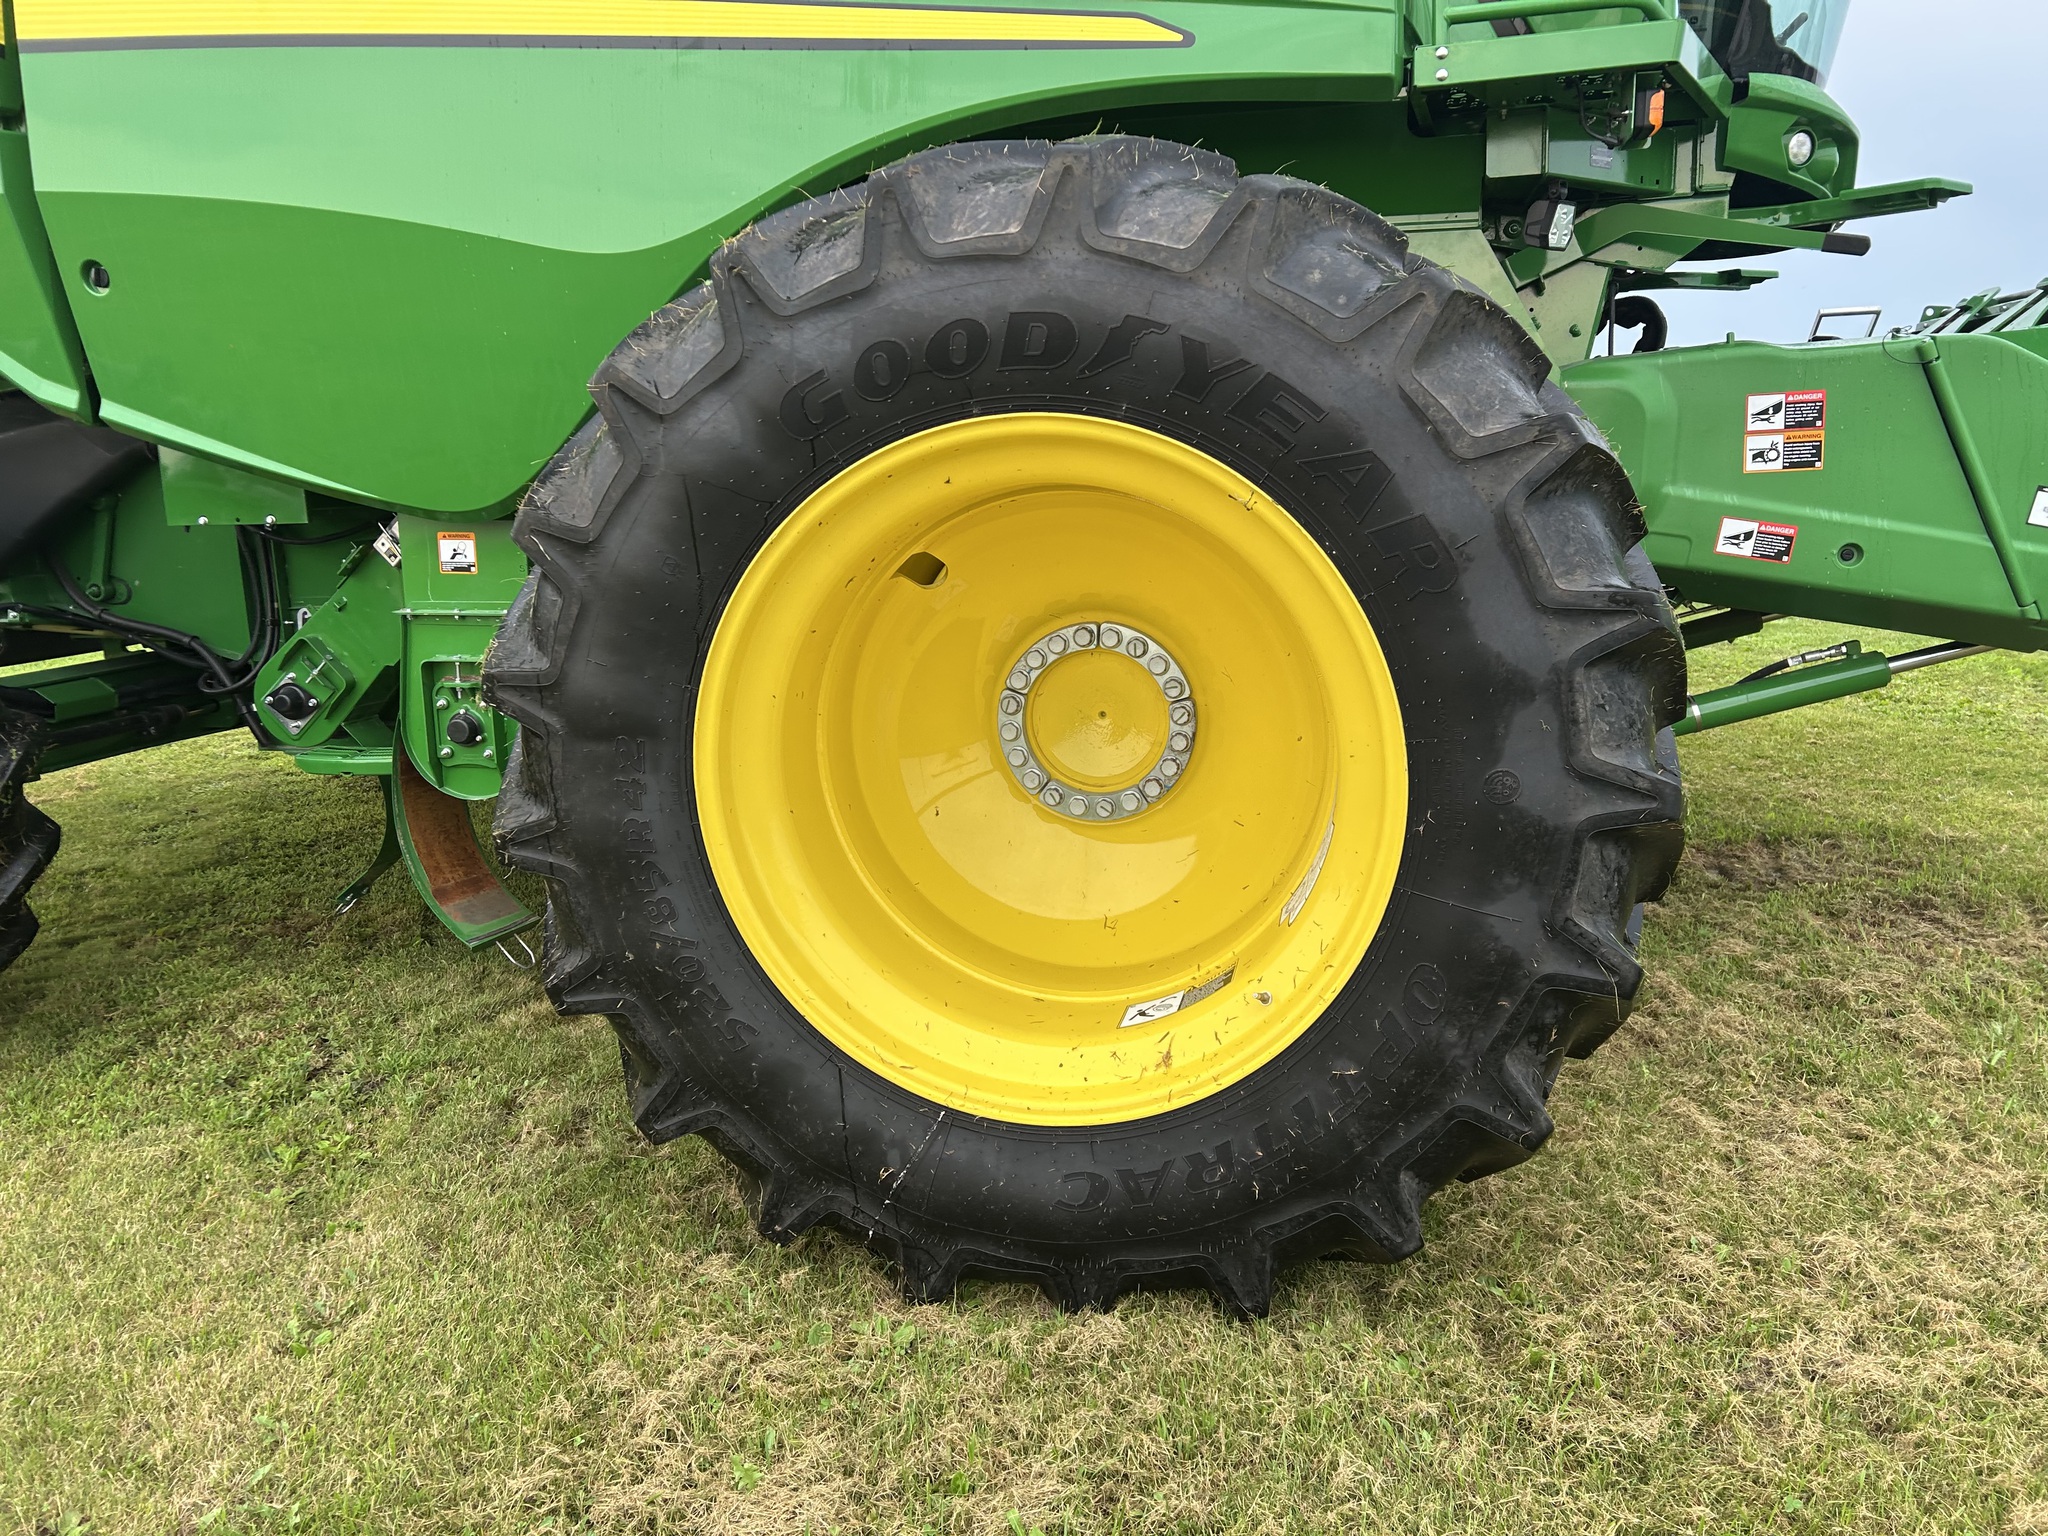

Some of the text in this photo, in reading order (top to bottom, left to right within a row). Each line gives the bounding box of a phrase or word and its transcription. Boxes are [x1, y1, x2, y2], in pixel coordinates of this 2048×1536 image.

[777, 309, 1460, 600] GOODYEAR
[1793, 393, 1823, 401] DANGER
[1765, 525, 1795, 535] DANGER
[613, 735, 761, 1053] 520/85R42
[1053, 962, 1449, 1213] OPTITRAC
